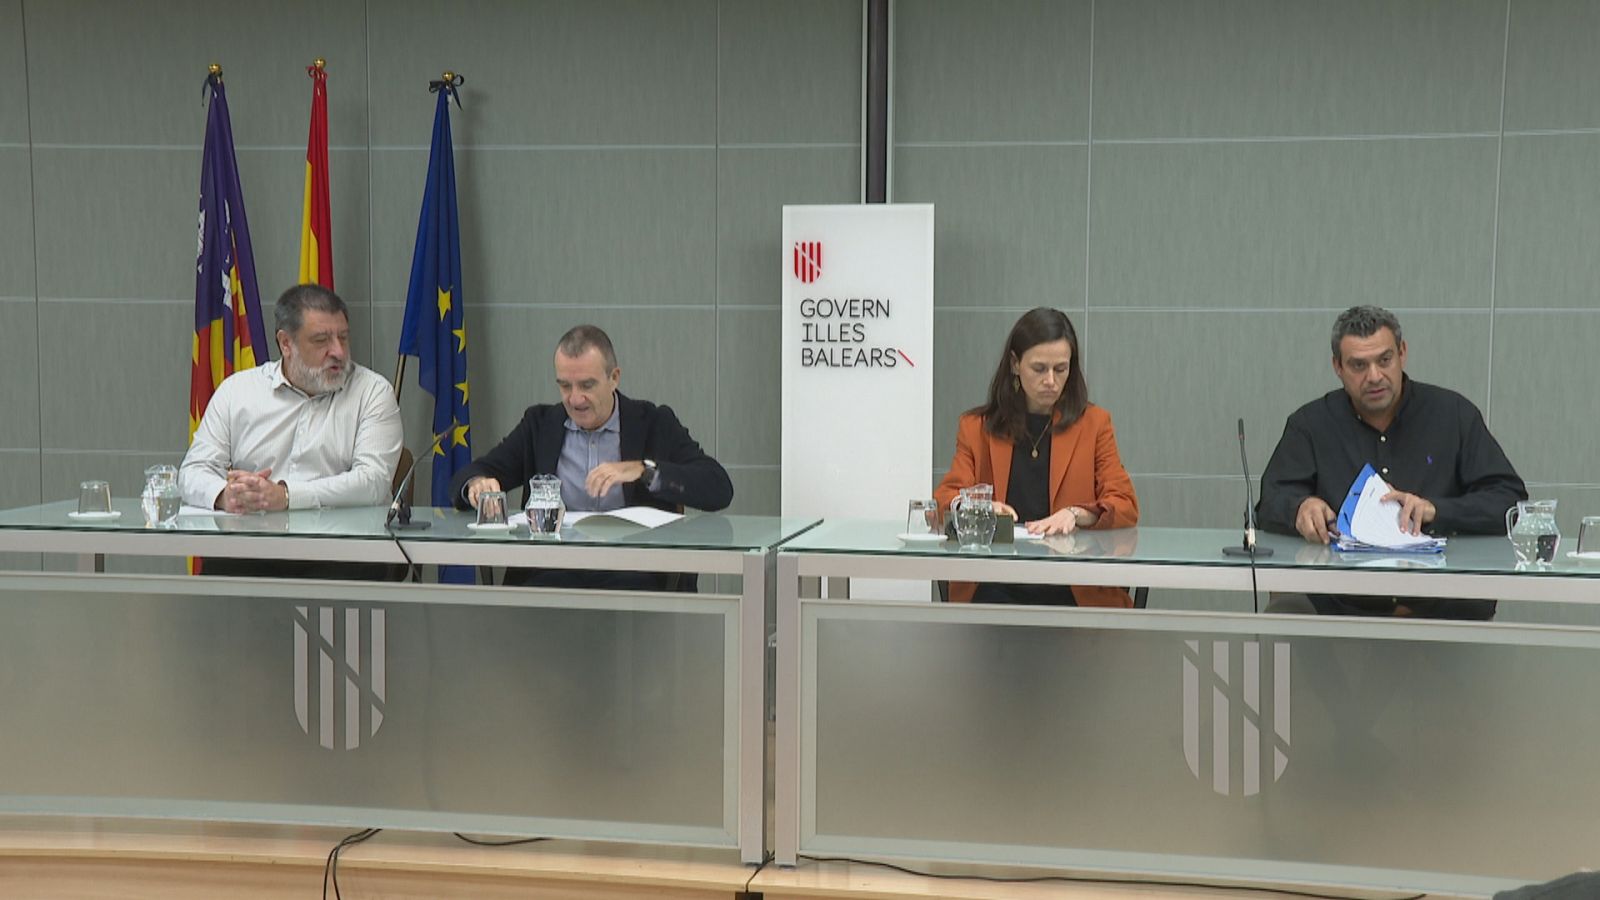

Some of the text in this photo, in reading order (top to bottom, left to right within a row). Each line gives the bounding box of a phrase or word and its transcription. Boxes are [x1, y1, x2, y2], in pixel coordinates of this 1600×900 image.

[800, 298, 890, 319] GOVERN
[801, 323, 865, 343] ILLES
[801, 347, 897, 367] BALEARS
